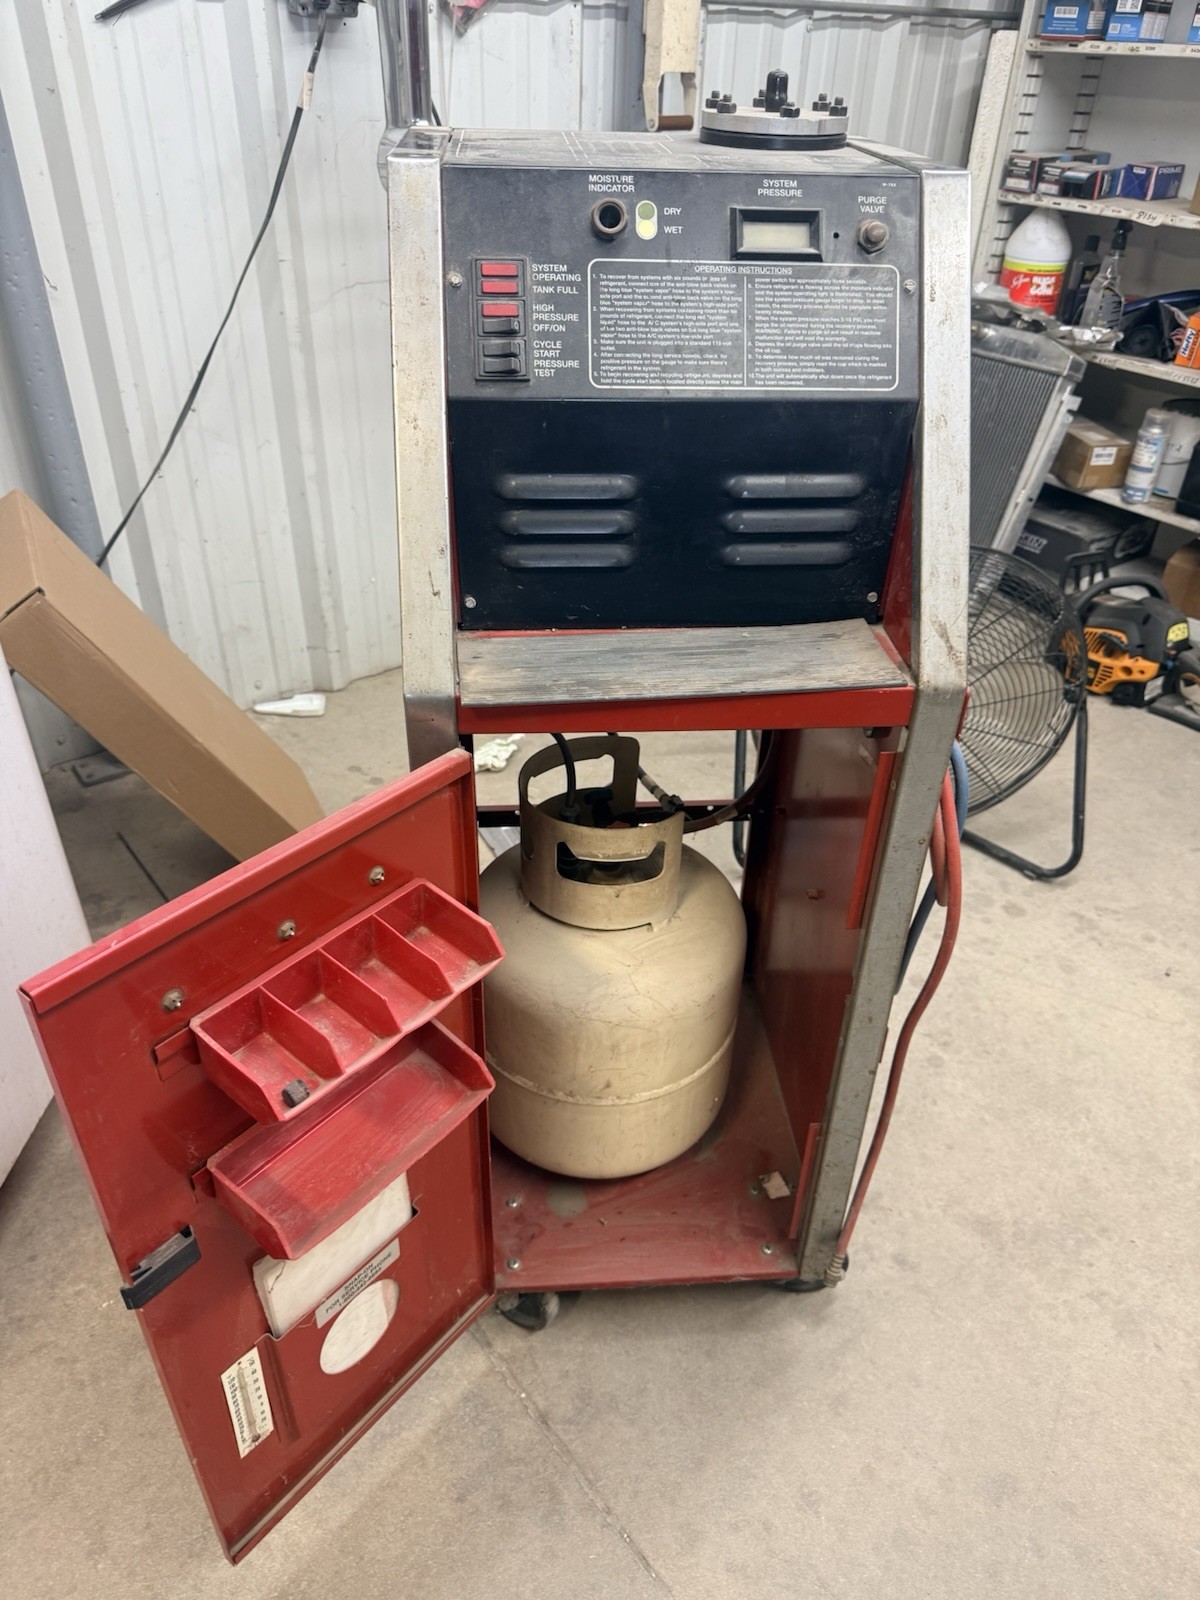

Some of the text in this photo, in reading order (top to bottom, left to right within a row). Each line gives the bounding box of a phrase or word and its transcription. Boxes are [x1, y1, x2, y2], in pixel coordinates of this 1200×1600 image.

[1158, 166, 1182, 174] PRIME
[588, 175, 634, 183] MOISTURE
[588, 184, 634, 192] INDICATOR
[758, 189, 802, 197] PRESSURE
[664, 207, 682, 215] DRY
[533, 274, 581, 282] OPERATING
[344, 1262, 373, 1291] SNAP-ON
[326, 1252, 392, 1314] FOR SERVICE PHONE
